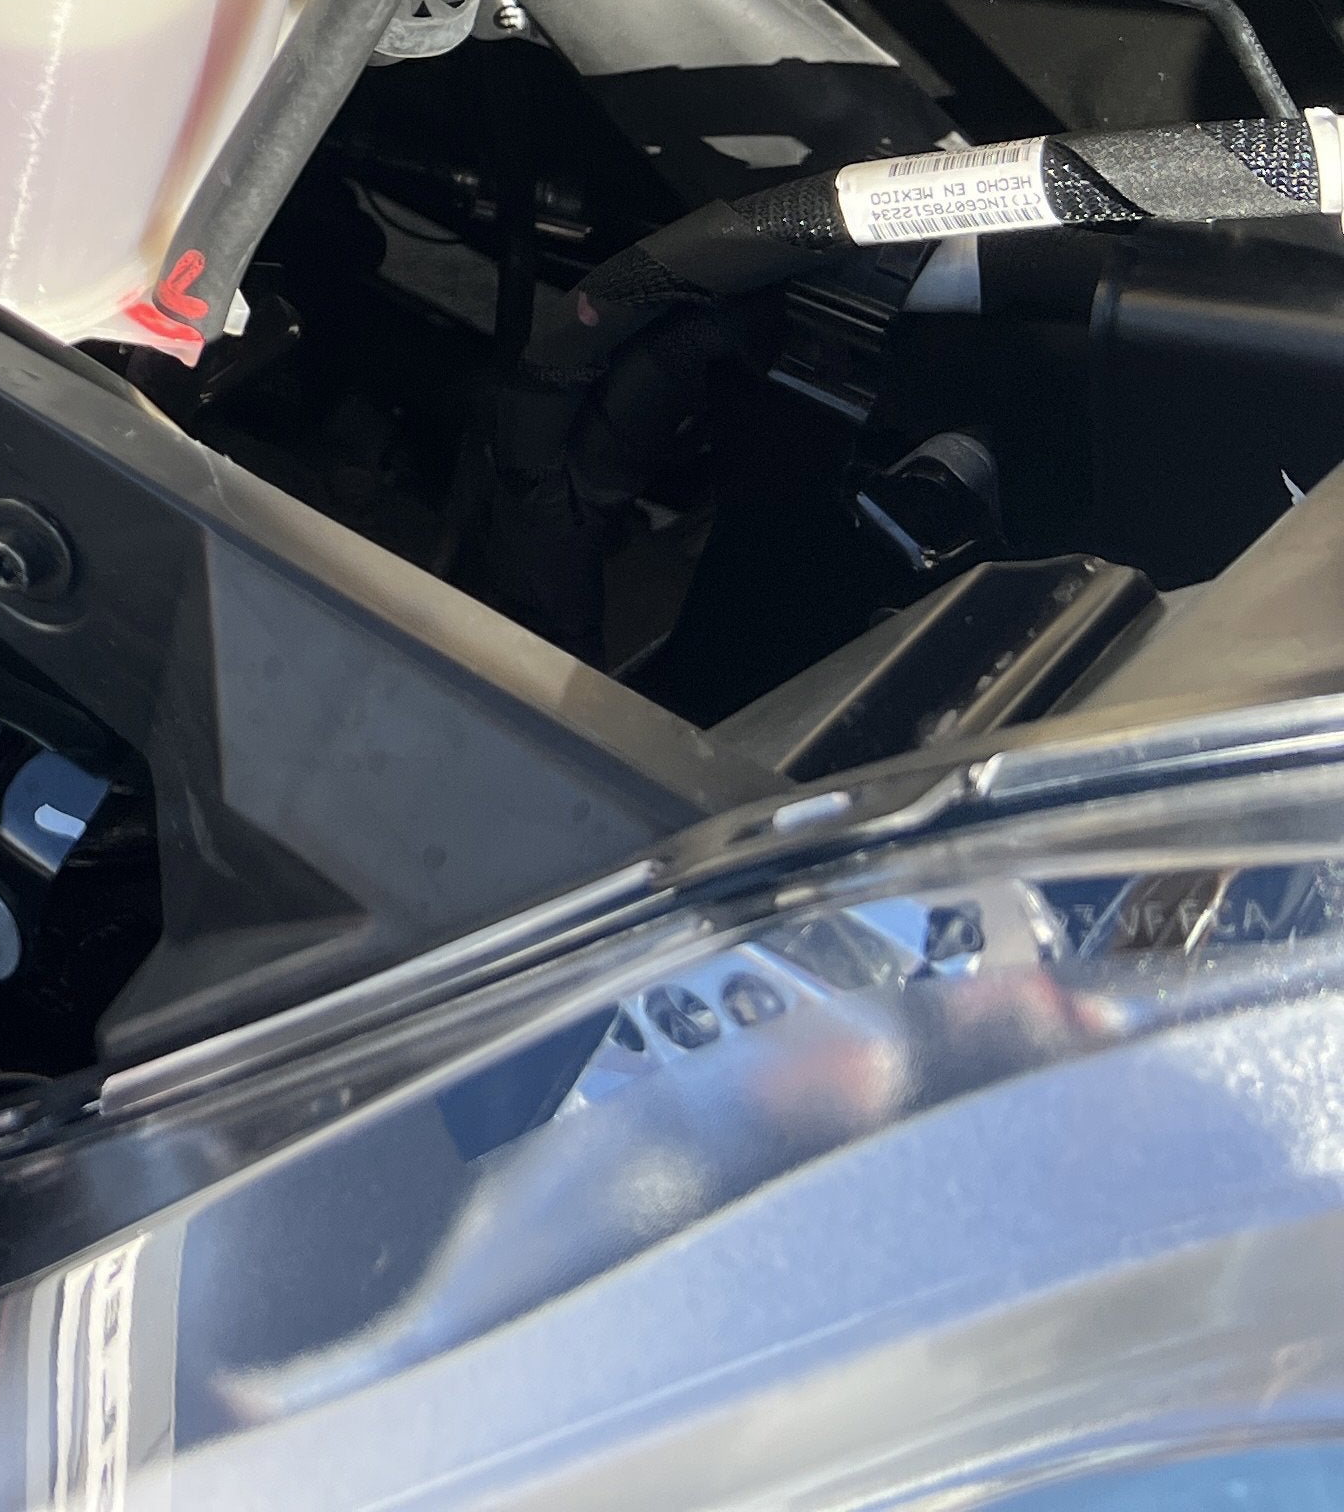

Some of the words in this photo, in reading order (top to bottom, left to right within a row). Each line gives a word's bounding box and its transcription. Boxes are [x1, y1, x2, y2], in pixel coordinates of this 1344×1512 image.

[944, 183, 966, 198] EN
[976, 175, 1033, 194] HECHO
[870, 187, 933, 206] MEXICO
